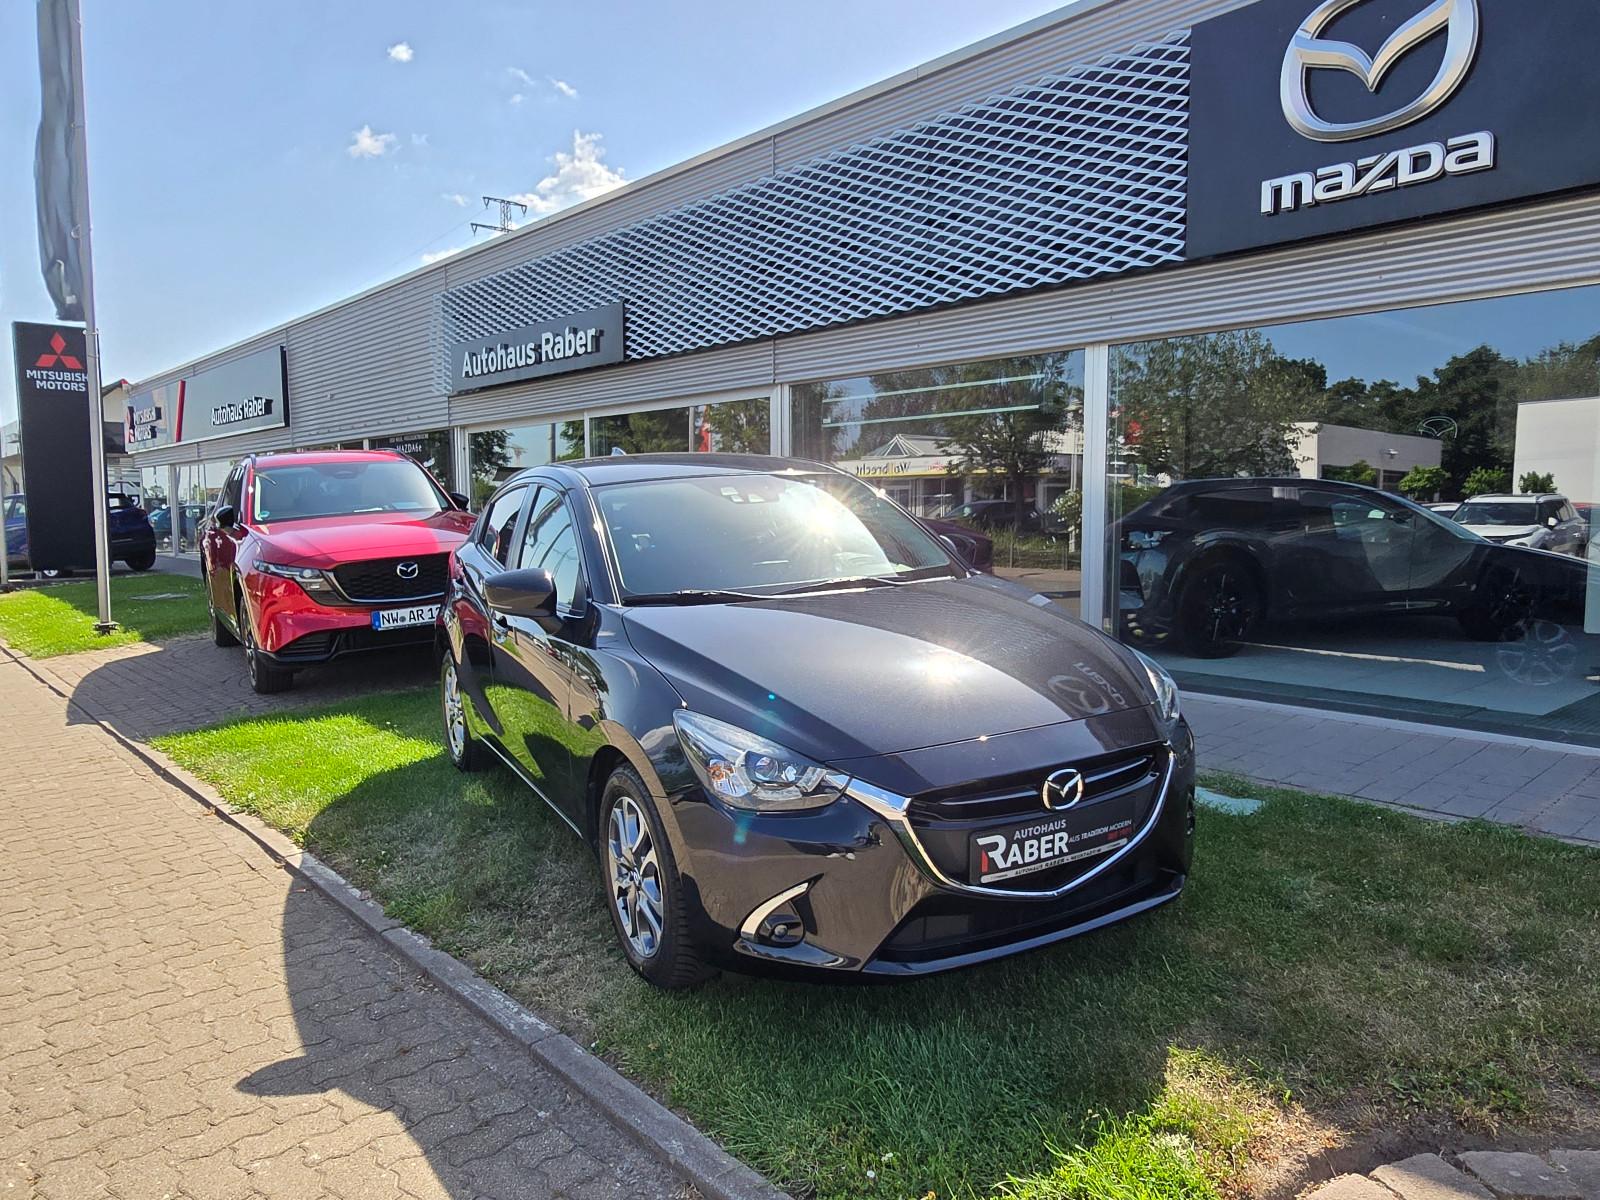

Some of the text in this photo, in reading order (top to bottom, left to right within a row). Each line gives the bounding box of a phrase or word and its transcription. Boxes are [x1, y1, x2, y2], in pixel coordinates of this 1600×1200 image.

[462, 326, 597, 378] Autohaus Raber
[26, 369, 88, 382] MITSUBISH
[36, 380, 86, 392] MOTORS
[211, 395, 266, 426] Autohaus Raber
[381, 611, 399, 625] NW
[409, 609, 426, 623] AR
[1014, 819, 1067, 840] AUTOHAUS
[976, 832, 1069, 872] RABER
